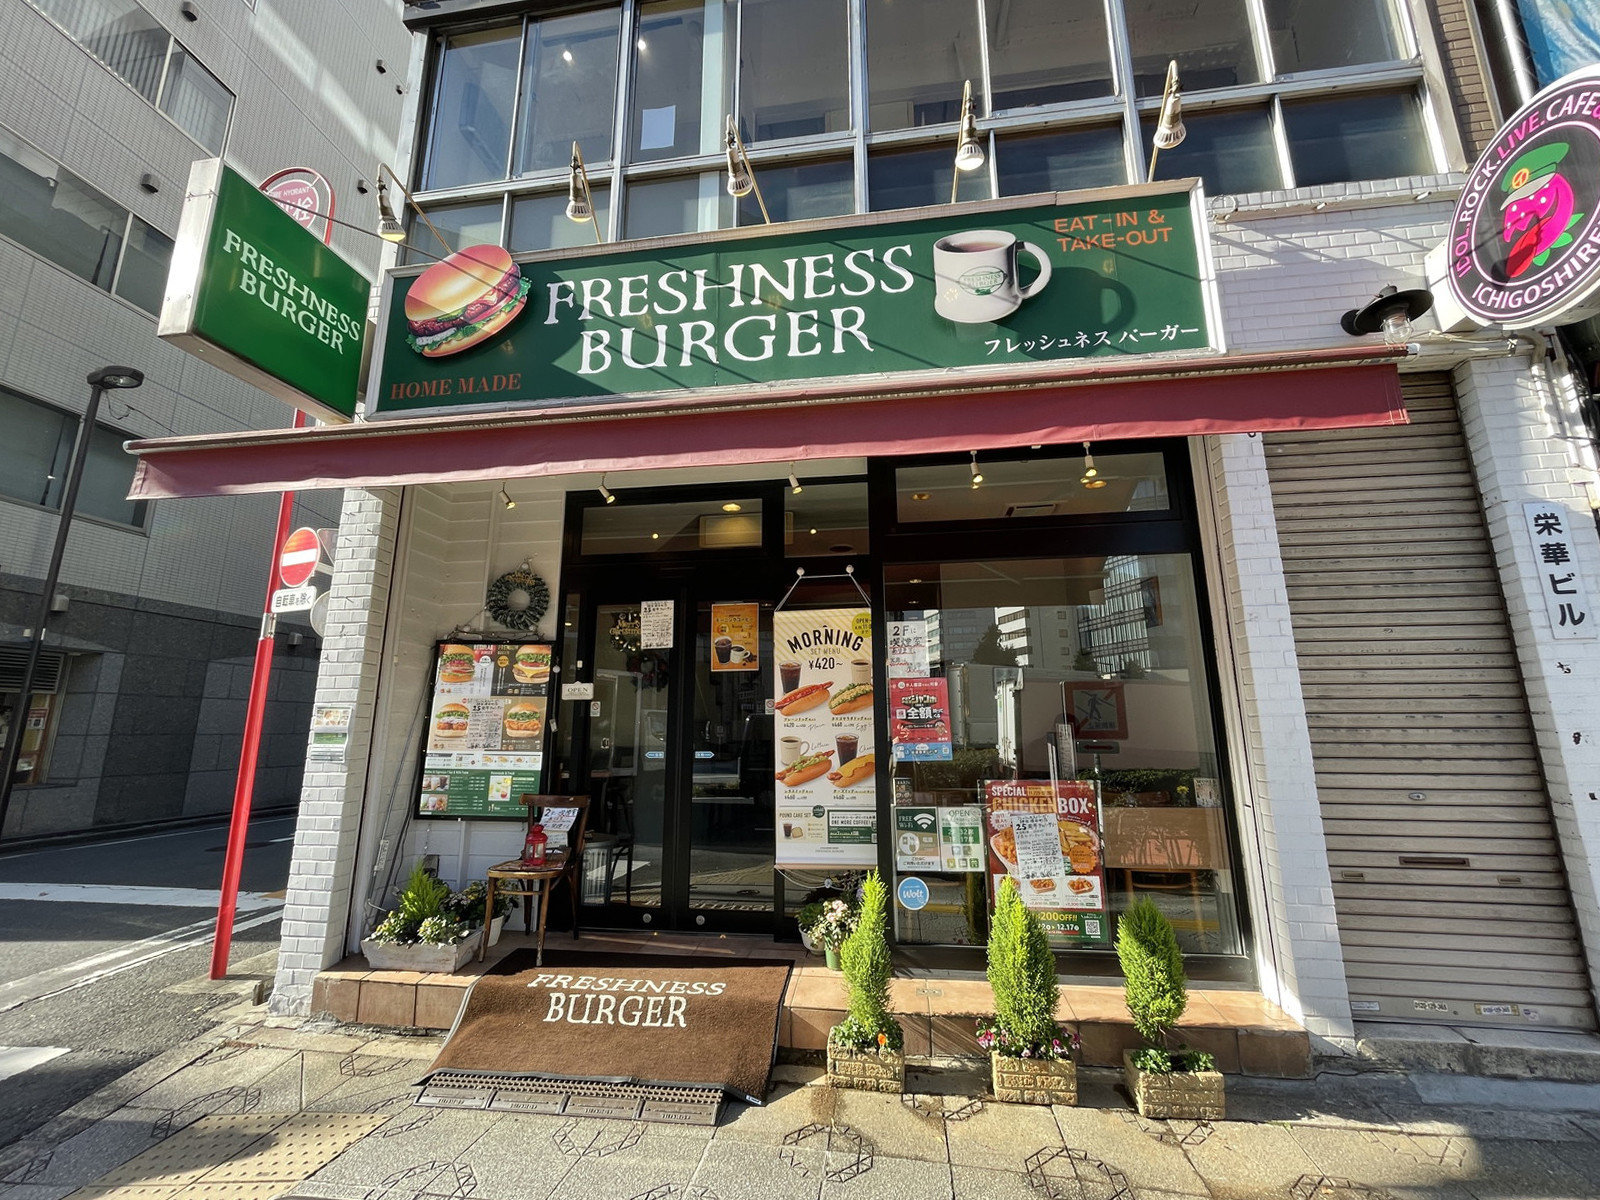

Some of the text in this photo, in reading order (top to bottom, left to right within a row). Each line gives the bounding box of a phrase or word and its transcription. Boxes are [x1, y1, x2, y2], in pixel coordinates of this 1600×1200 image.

[1054, 208, 1165, 234] EAT-IN &
[1056, 227, 1173, 252] TAKE-OUT
[1472, 220, 1600, 309] ICHIGOSHIRE
[223, 229, 361, 341] FRESHNESS
[544, 244, 915, 325] FRESHNESS
[239, 268, 344, 355] BURGER
[577, 305, 875, 375] BURGER
[984, 324, 1200, 356] フレッシュネス バーガー
[390, 373, 522, 400] HOME MADE
[1532, 512, 1586, 628] 栄華ビル
[787, 628, 864, 654] MORNING
[823, 647, 841, 655] MENU
[907, 706, 932, 719] 全額
[991, 785, 1027, 797] SPECIAL
[992, 796, 1090, 814] CHICKEN BOX
[902, 889, 924, 899] Wolt
[527, 973, 727, 996] FRESHNESS
[543, 992, 687, 1028] BURGER
